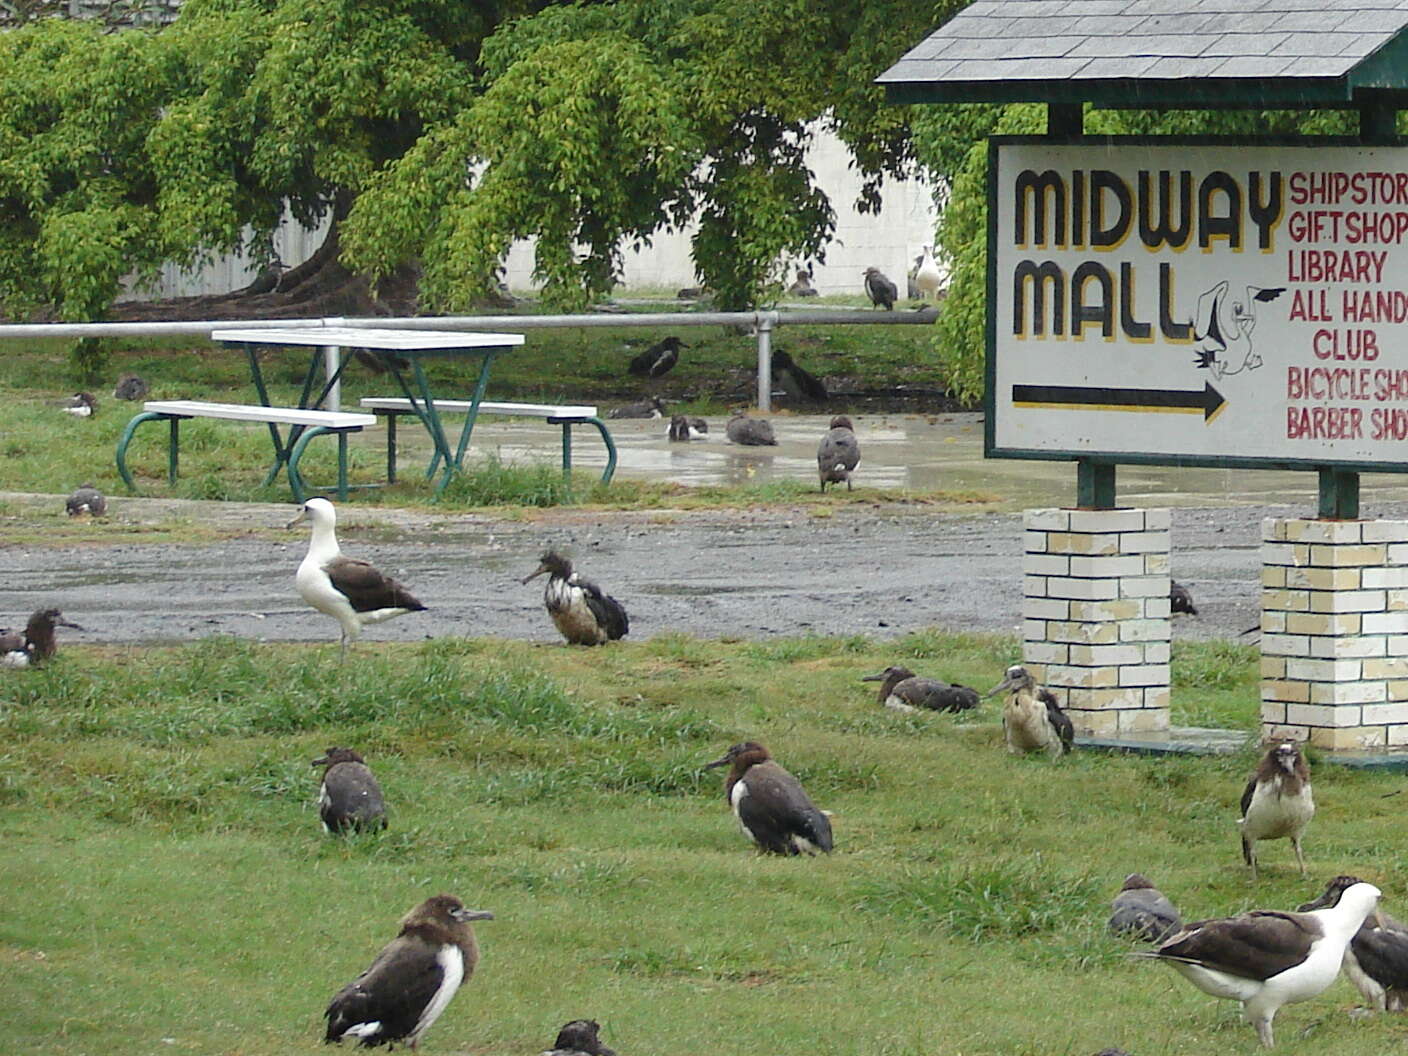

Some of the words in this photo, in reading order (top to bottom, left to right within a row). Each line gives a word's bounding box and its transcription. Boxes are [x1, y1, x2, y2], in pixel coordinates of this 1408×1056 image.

[1014, 169, 1285, 254] MIDWAY
[1288, 249, 1388, 283] LIBRARY
[1013, 259, 1195, 344] MALL
[1289, 289, 1333, 322] ALL
[1313, 328, 1380, 361] CLUB
[1287, 366, 1371, 401] BICYCLE
[1287, 406, 1363, 440] BARBER
